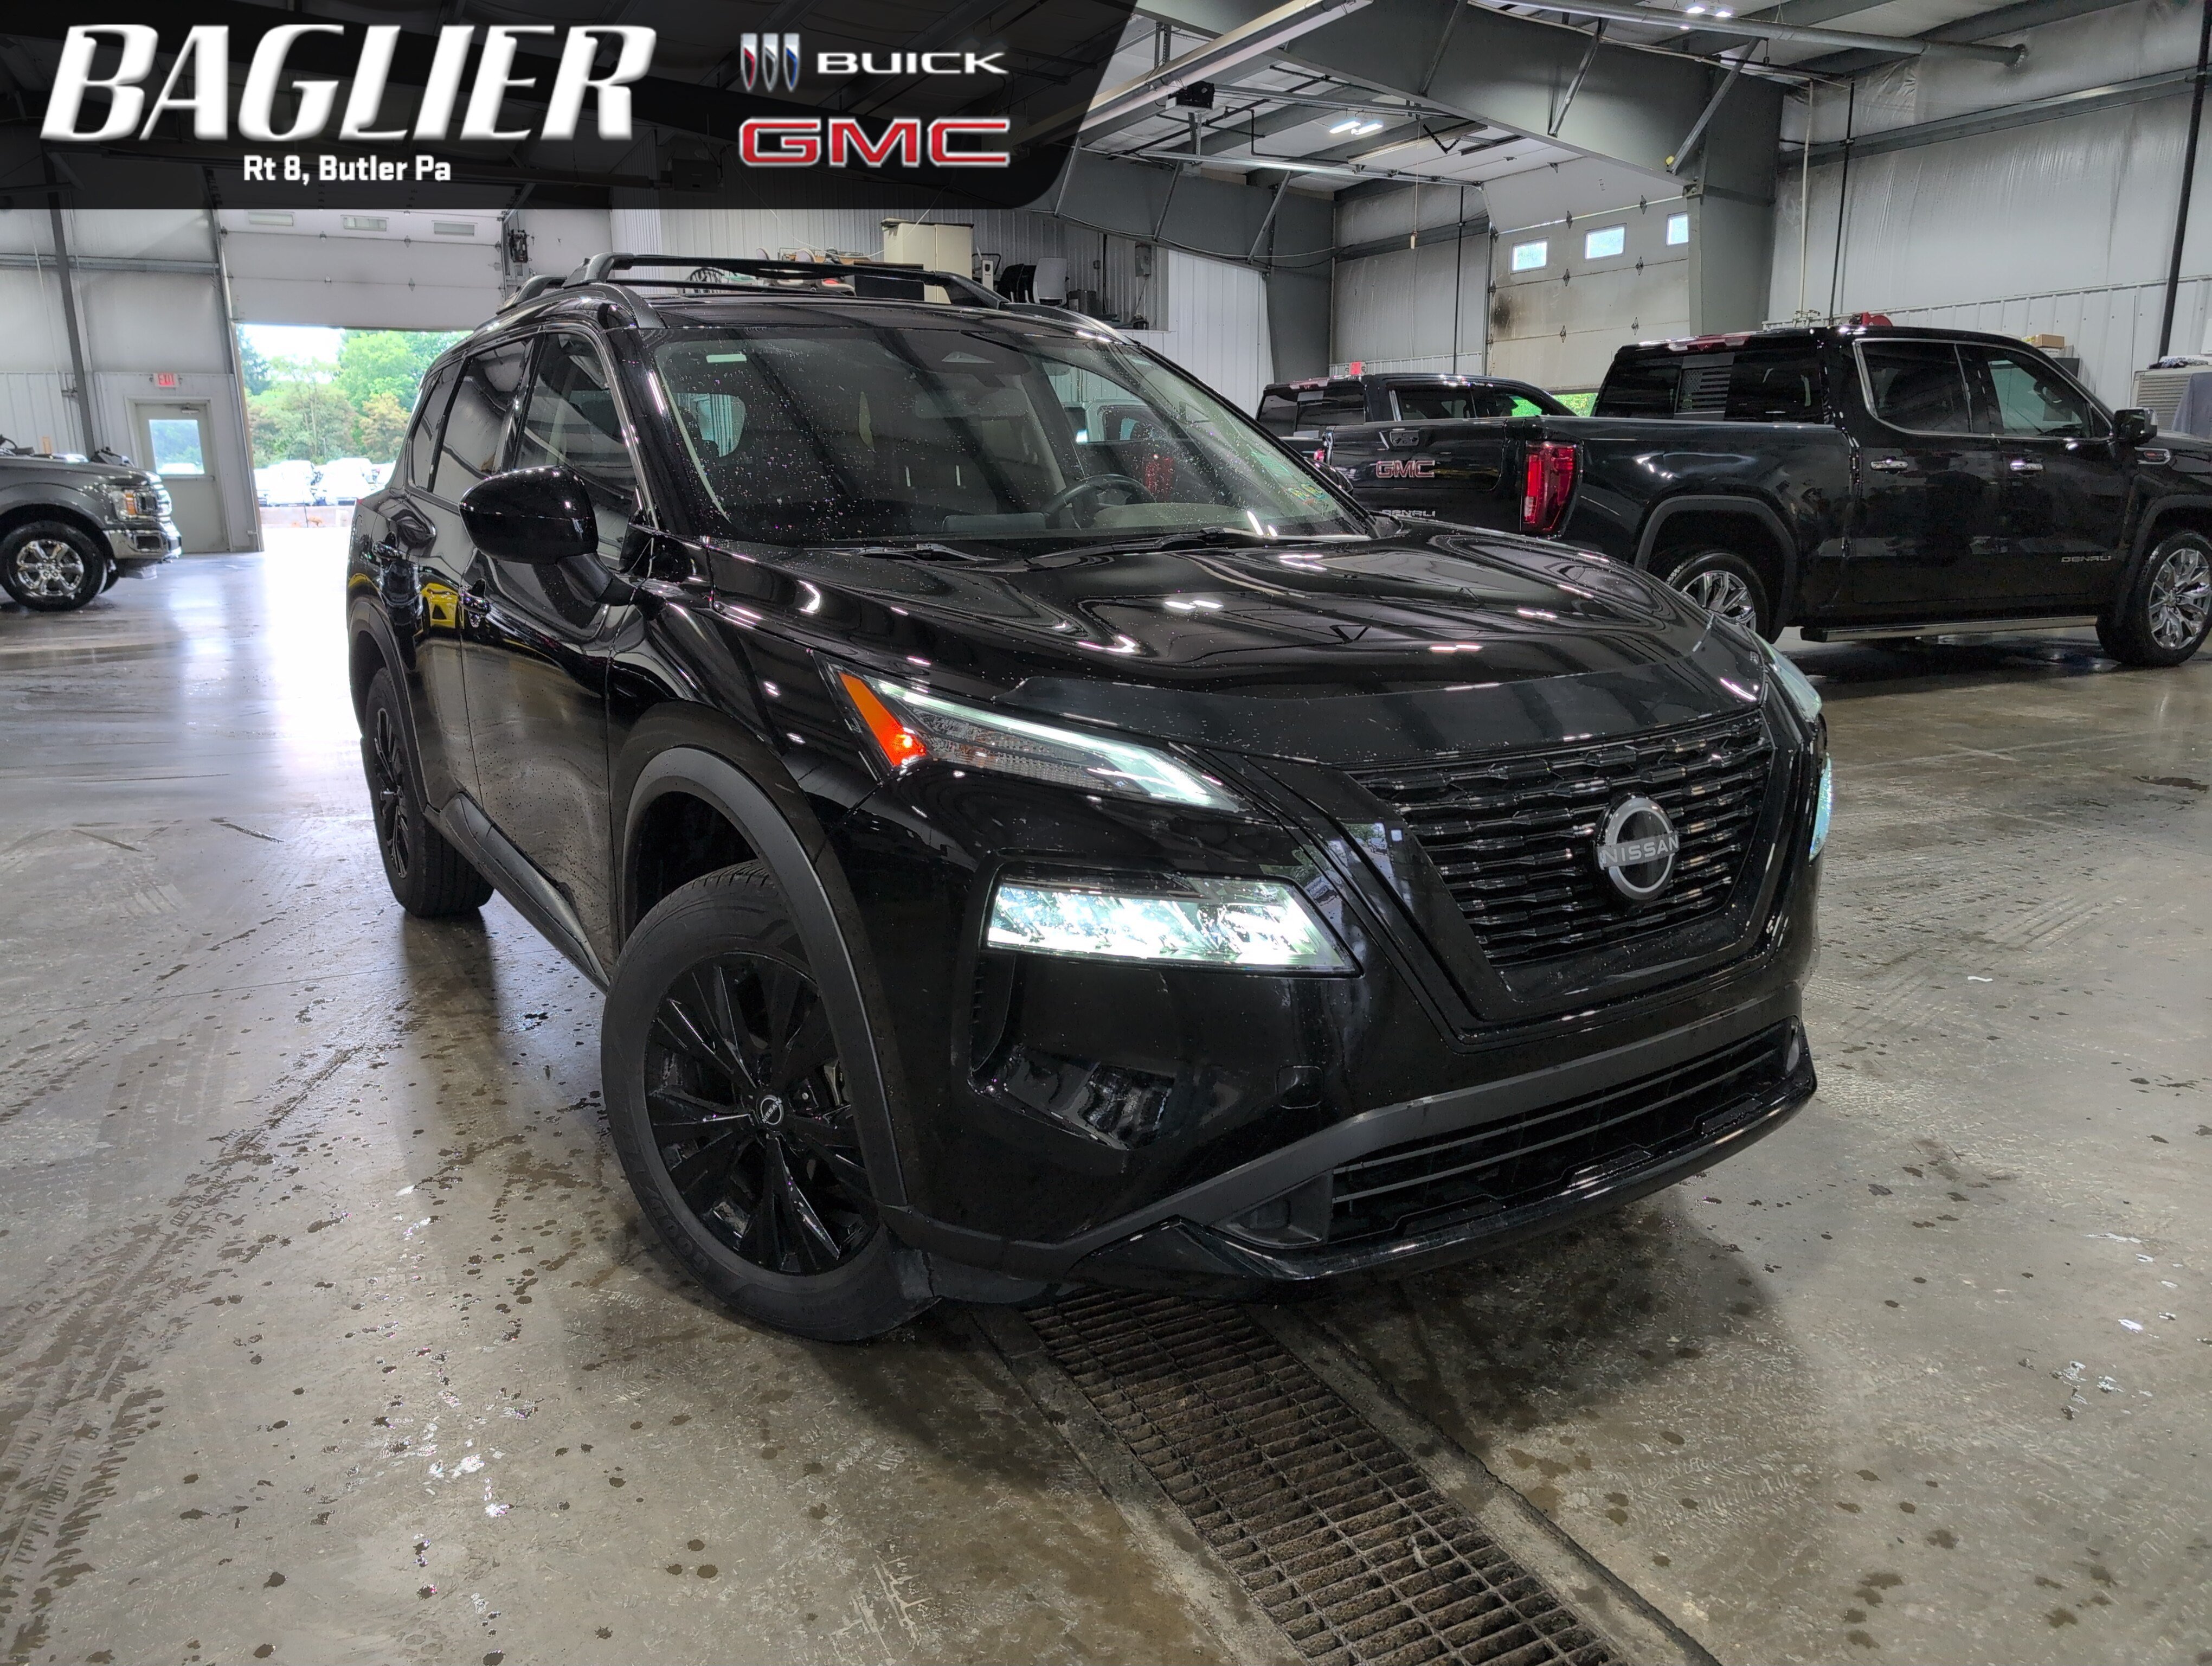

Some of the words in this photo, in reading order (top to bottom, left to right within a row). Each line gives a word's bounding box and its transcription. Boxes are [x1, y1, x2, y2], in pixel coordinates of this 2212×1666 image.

[1376, 460, 1435, 478] GMC
[1599, 834, 1679, 864] NISSAN
[762, 1097, 782, 1123] NISSAN
